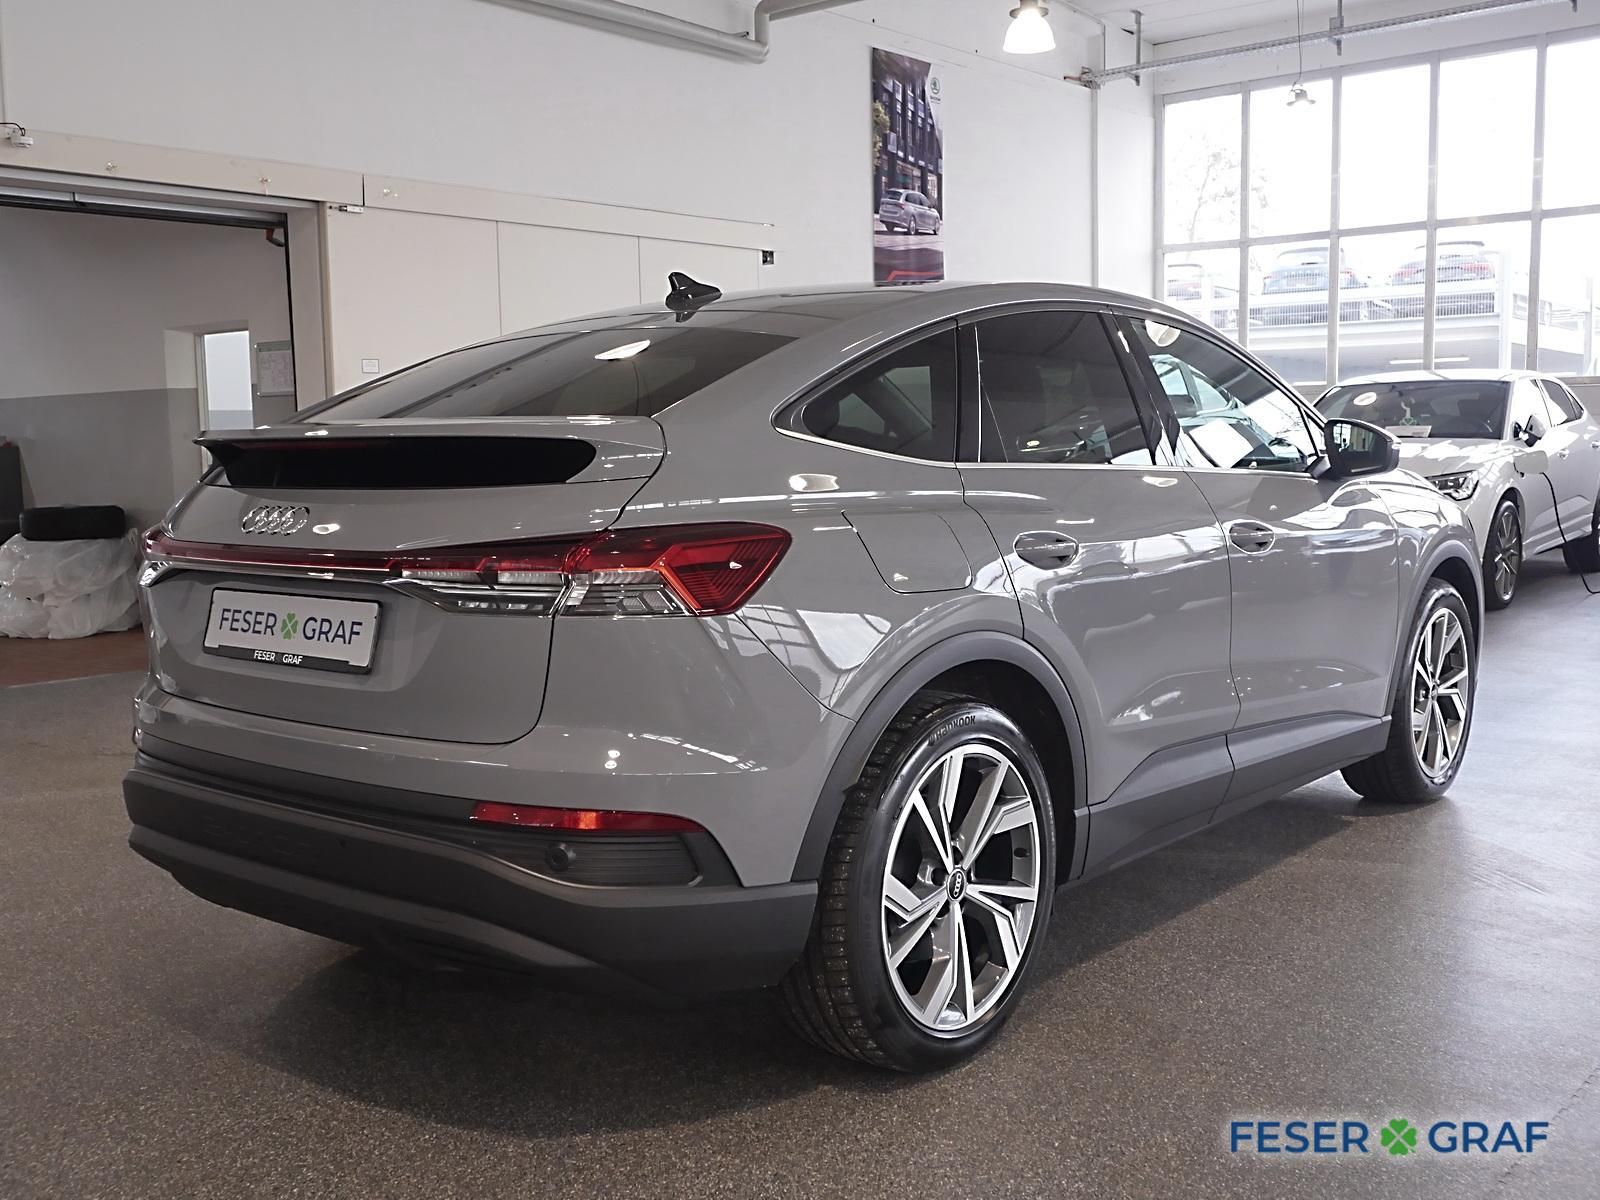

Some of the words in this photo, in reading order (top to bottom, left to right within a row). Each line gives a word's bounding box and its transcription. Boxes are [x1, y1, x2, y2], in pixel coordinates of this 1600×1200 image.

[219, 608, 277, 636] FESER
[302, 616, 363, 645] GRAF
[253, 650, 276, 662] FESER
[282, 654, 303, 665] GRAF
